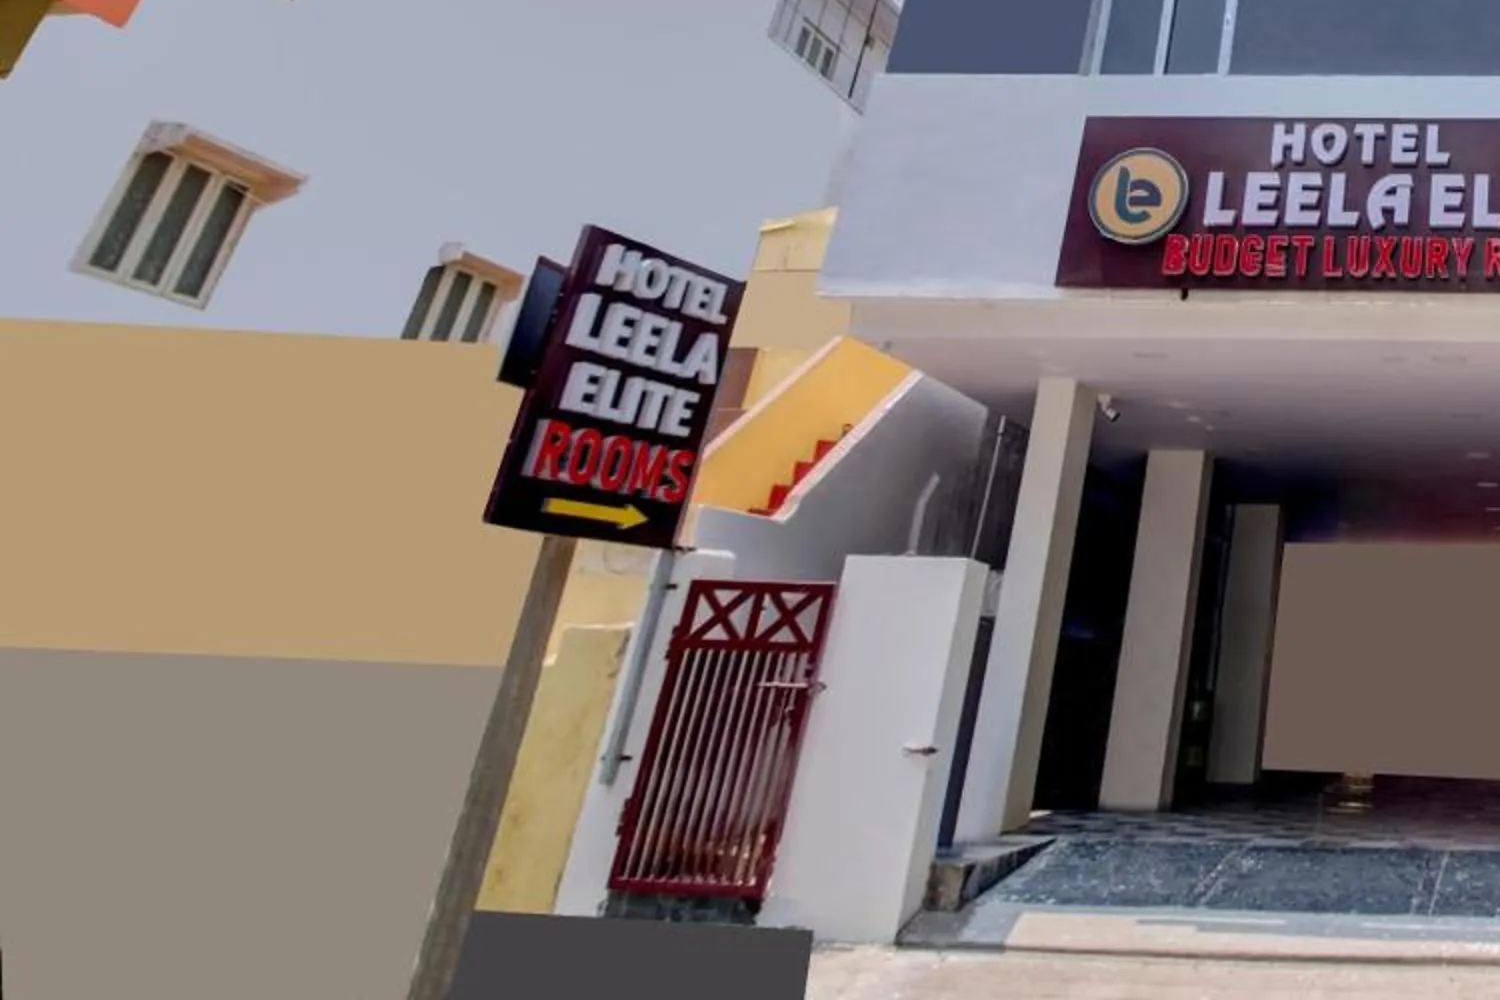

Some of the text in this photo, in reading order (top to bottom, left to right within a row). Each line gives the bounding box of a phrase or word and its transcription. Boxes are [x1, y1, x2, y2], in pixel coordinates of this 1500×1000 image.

[1271, 122, 1450, 168] HOTEL
[1201, 170, 1412, 232] LEELA
[595, 243, 728, 324] HOTEL
[1161, 233, 1317, 278] BUDGET
[1323, 235, 1474, 279] LUXURY
[565, 292, 719, 385] LEELA
[558, 361, 701, 438] ELITE
[521, 418, 695, 502] ROOMS
